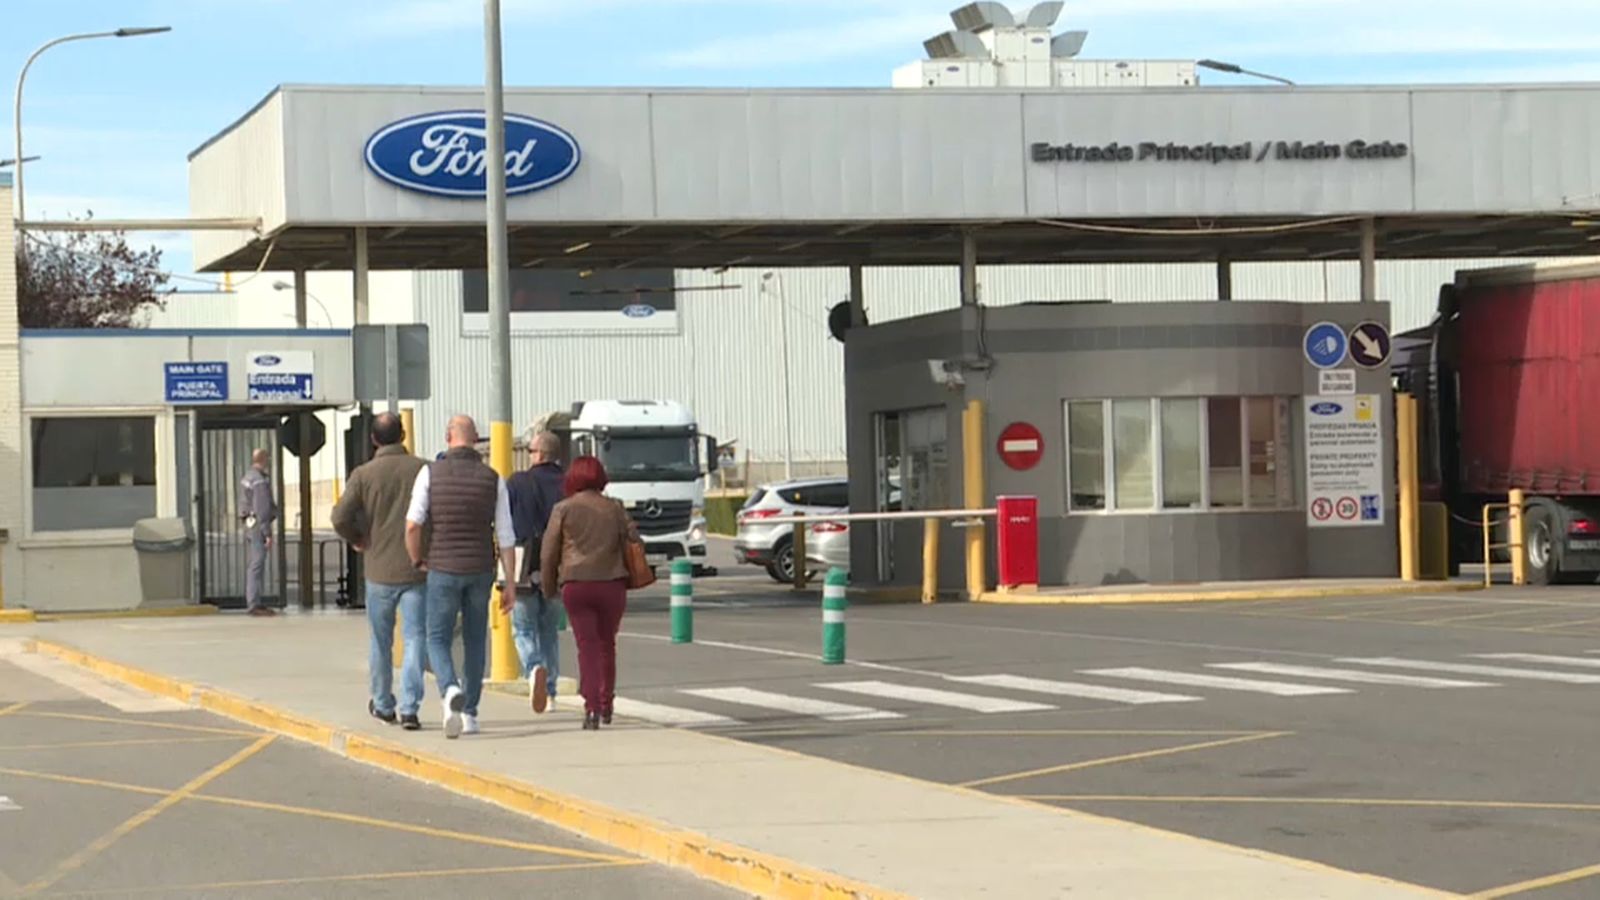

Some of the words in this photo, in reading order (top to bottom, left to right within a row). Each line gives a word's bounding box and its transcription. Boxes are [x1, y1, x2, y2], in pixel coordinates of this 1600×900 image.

[1031, 142, 1133, 162] Entrada
[1137, 141, 1252, 165] Principal
[1275, 140, 1341, 160] Main
[1345, 139, 1408, 159] Gate
[169, 365, 194, 374] MAIN
[196, 364, 223, 374] GATE
[249, 374, 296, 385] Entrada
[177, 381, 217, 390] PUERTA
[171, 390, 223, 399] PRINCIPAL
